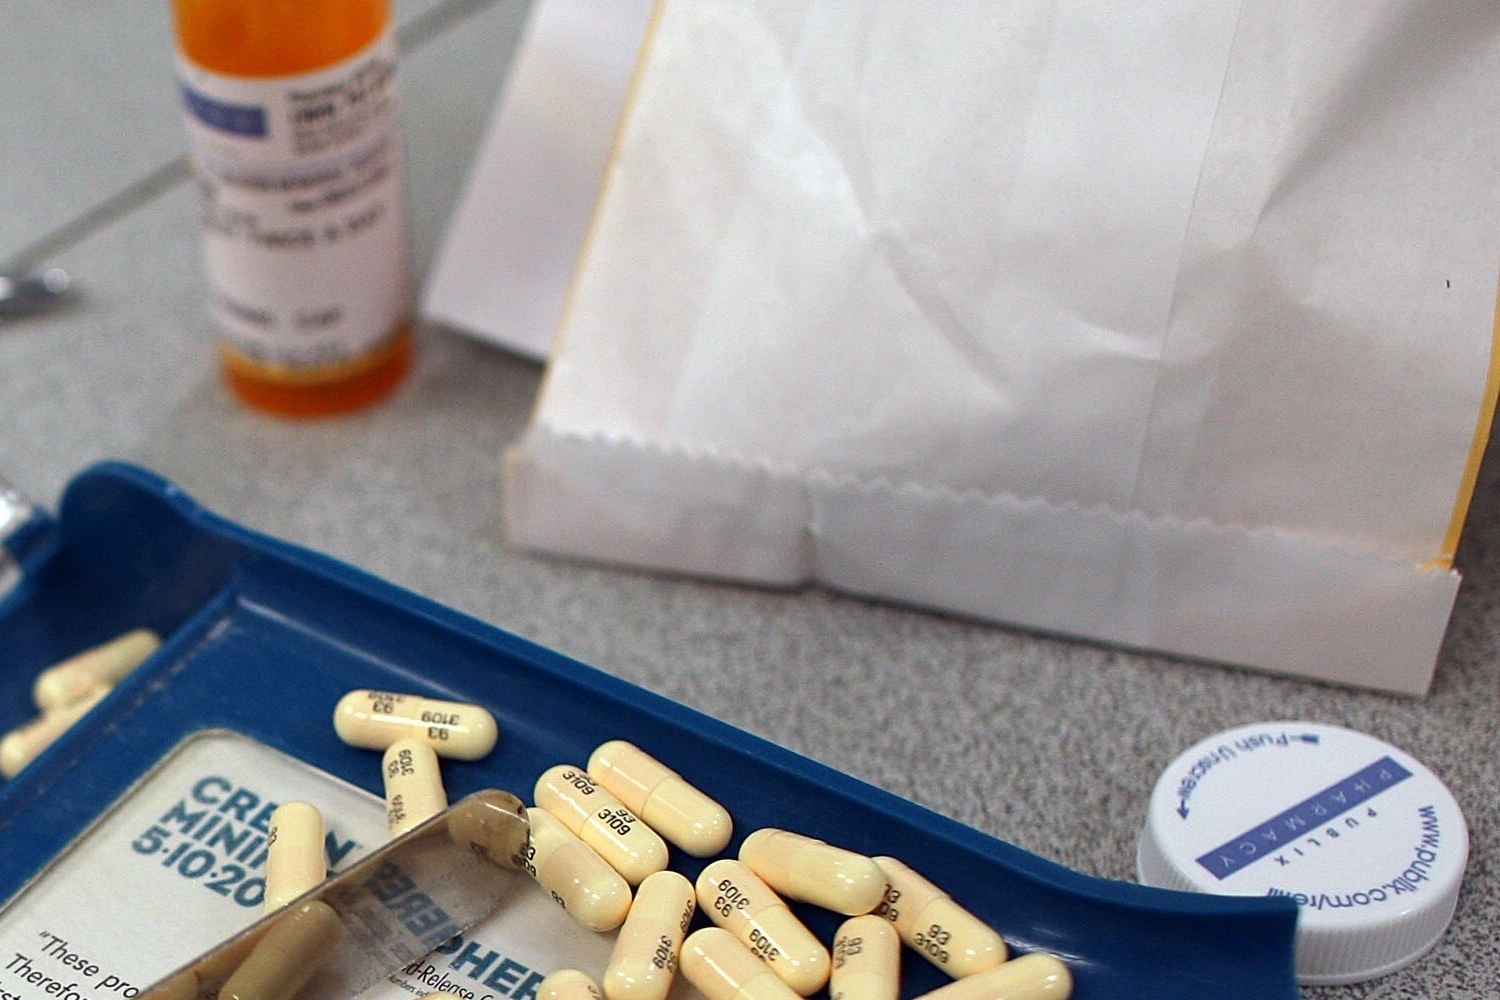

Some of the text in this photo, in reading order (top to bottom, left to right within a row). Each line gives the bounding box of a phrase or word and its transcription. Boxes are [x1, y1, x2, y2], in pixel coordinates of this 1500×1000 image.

[399, 749, 415, 777] 3109
[562, 771, 595, 796] 3109
[191, 776, 362, 867] CREN
[598, 808, 631, 836] 3109
[615, 808, 636, 824] 93
[1220, 770, 1393, 870] PHARMACY
[1275, 807, 1378, 867] PUBLIX
[1268, 805, 1441, 910] www.publix.com/rel
[714, 896, 733, 918] 93
[717, 879, 750, 910] 3109
[749, 929, 781, 962] 3109
[914, 932, 949, 963] 3109
[927, 924, 950, 946] 93
[652, 935, 672, 969] 3109
[94, 971, 139, 1000] pro
